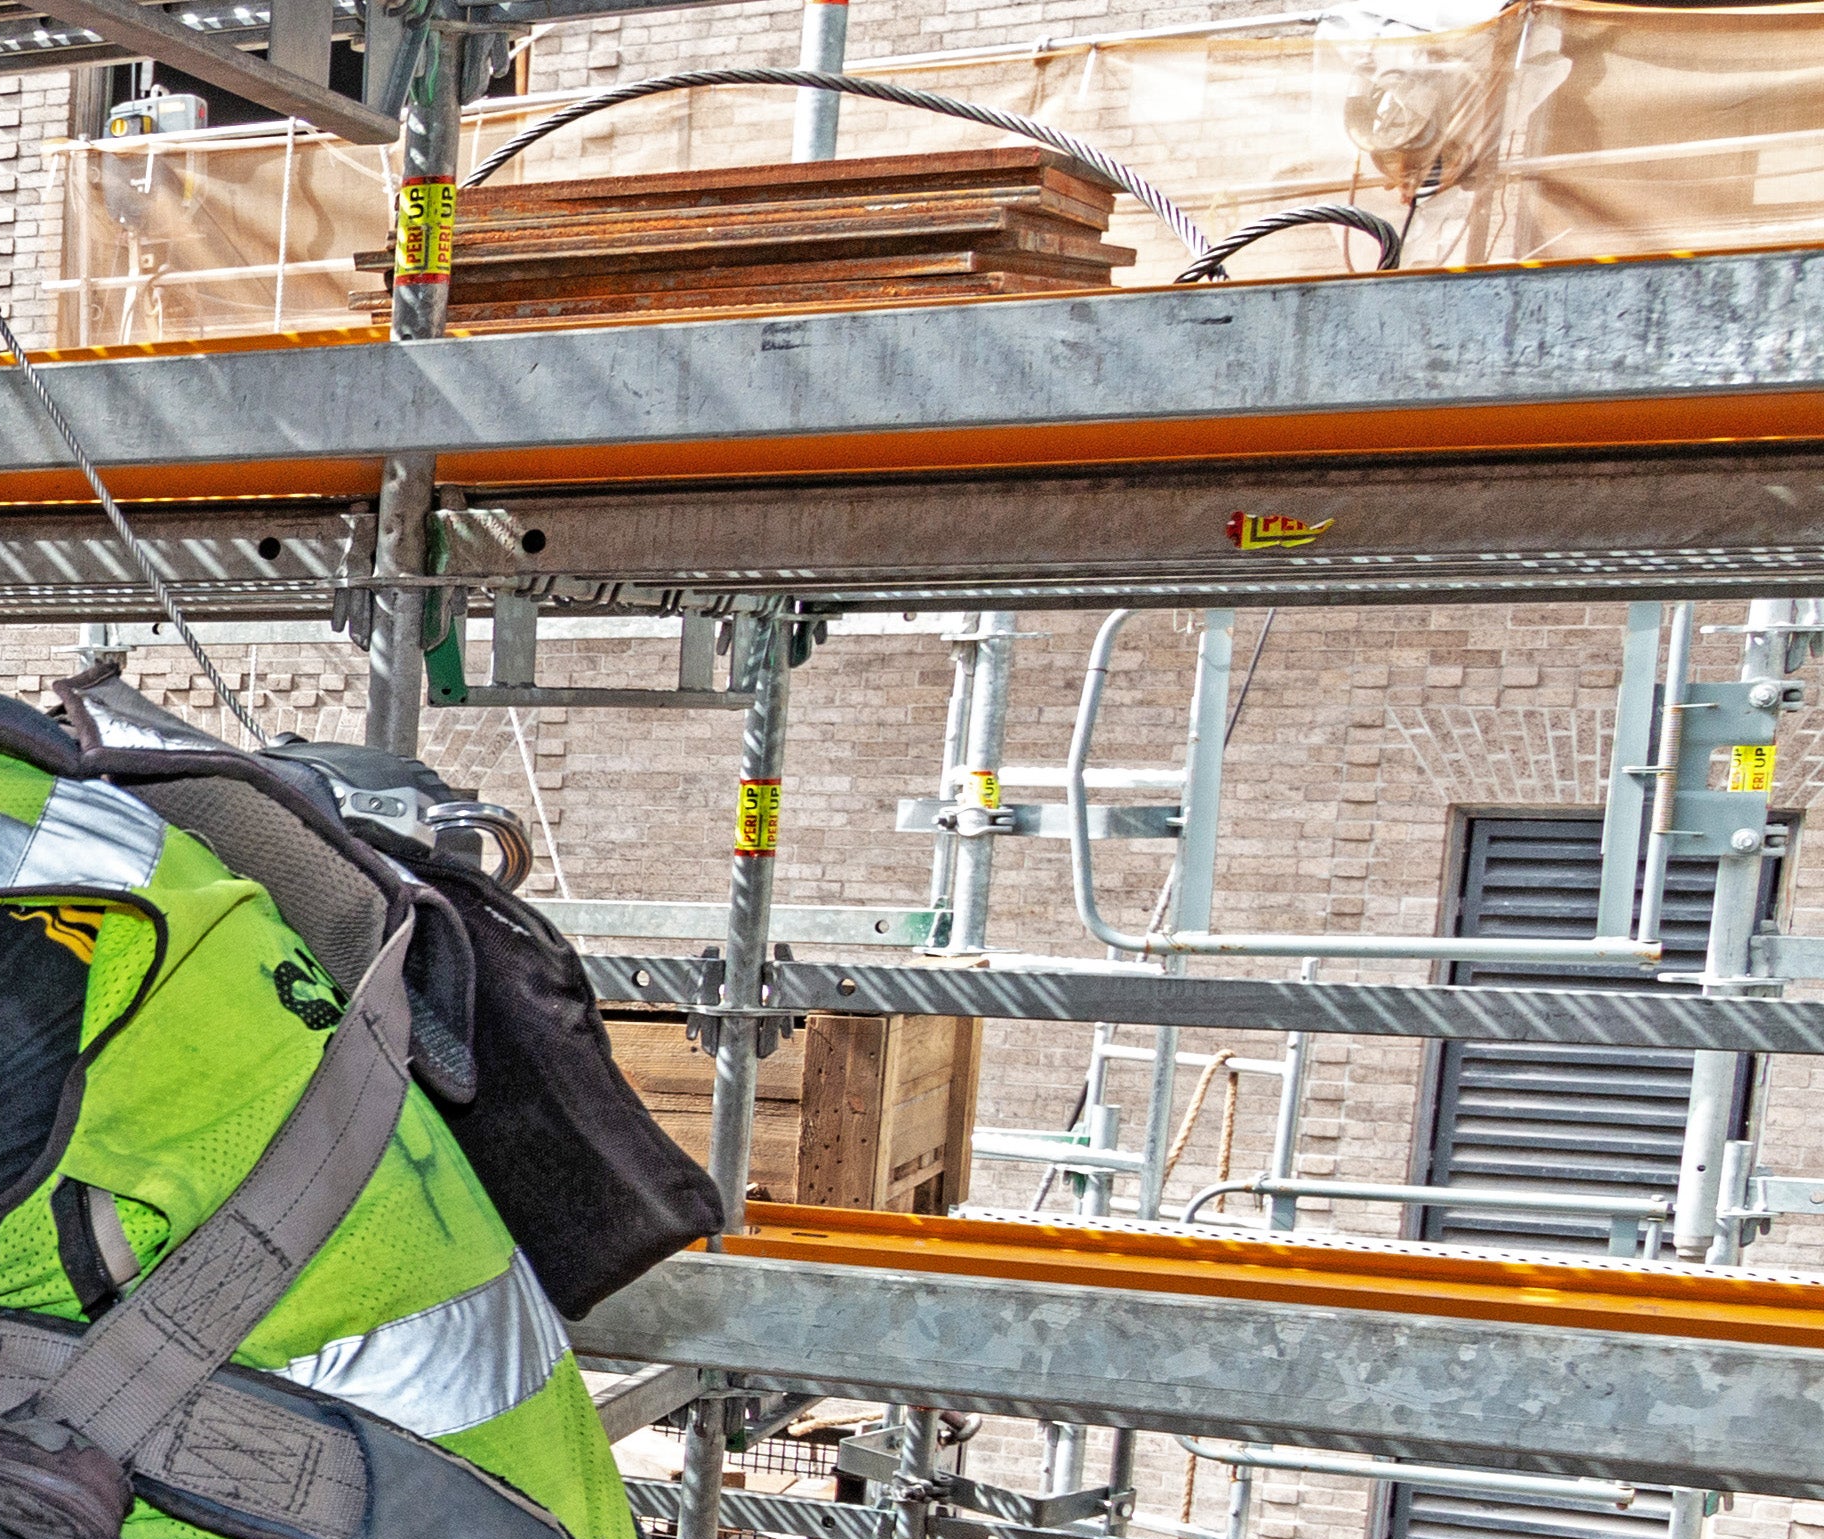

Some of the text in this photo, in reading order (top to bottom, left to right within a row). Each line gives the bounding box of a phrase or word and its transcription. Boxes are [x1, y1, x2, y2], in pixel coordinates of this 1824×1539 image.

[406, 188, 424, 264] PERI UP
[438, 187, 453, 263] PERI UP
[1752, 747, 1766, 790] ERI UP
[744, 787, 759, 843] PERI UP
[768, 787, 780, 843] PERI UP
